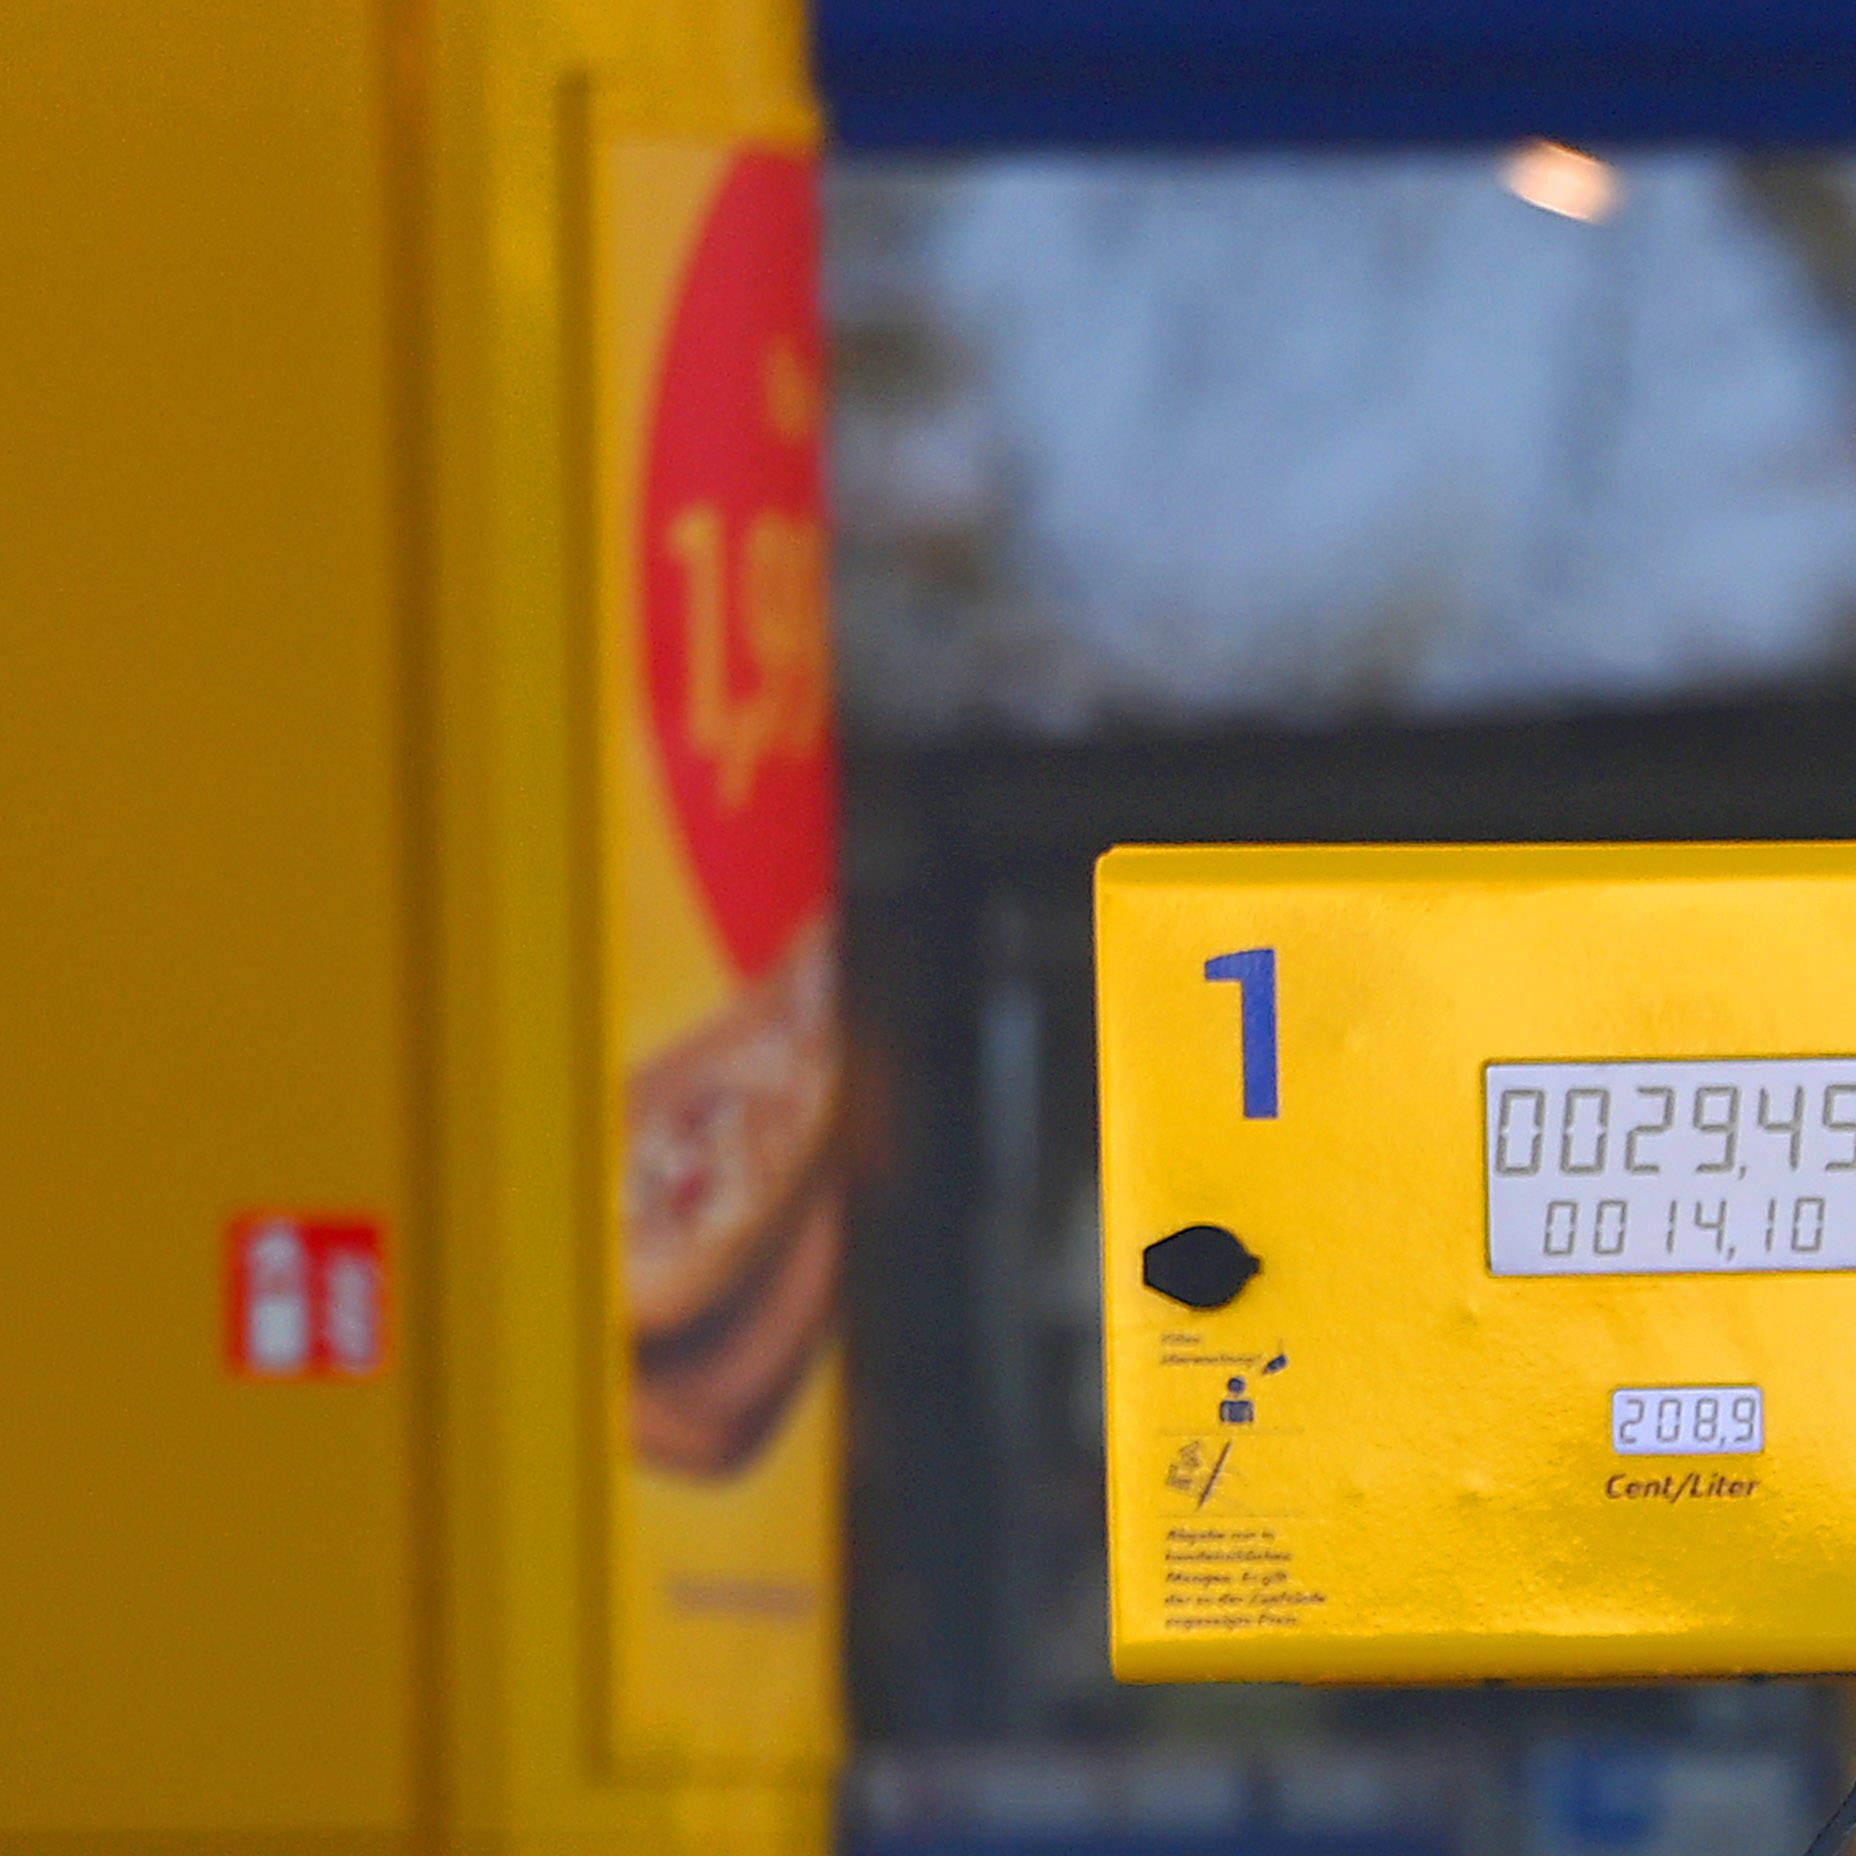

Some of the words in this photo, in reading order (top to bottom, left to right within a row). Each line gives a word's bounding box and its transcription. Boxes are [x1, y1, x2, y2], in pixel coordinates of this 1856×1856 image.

[1204, 946, 1280, 1120] 1
[1542, 1196, 1827, 1261] 0014,10
[1618, 1396, 1757, 1448] 208,9
[1605, 1472, 1762, 1504] Cent/Liter
